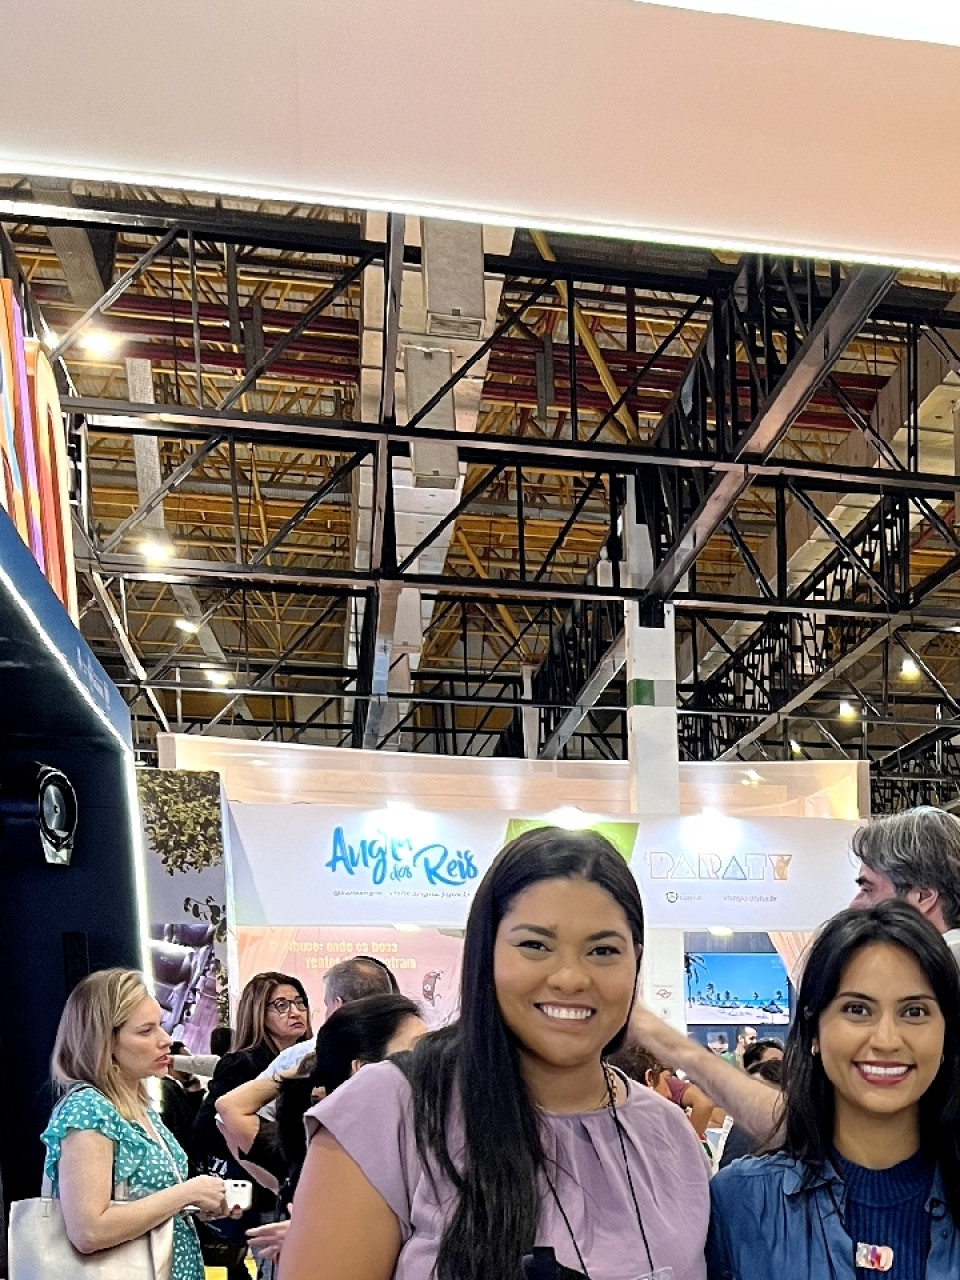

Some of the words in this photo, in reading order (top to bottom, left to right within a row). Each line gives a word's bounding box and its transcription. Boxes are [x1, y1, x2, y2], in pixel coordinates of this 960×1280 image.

[390, 863, 413, 881] dos
[413, 843, 479, 886] Reis
[649, 851, 793, 881] PARATY
